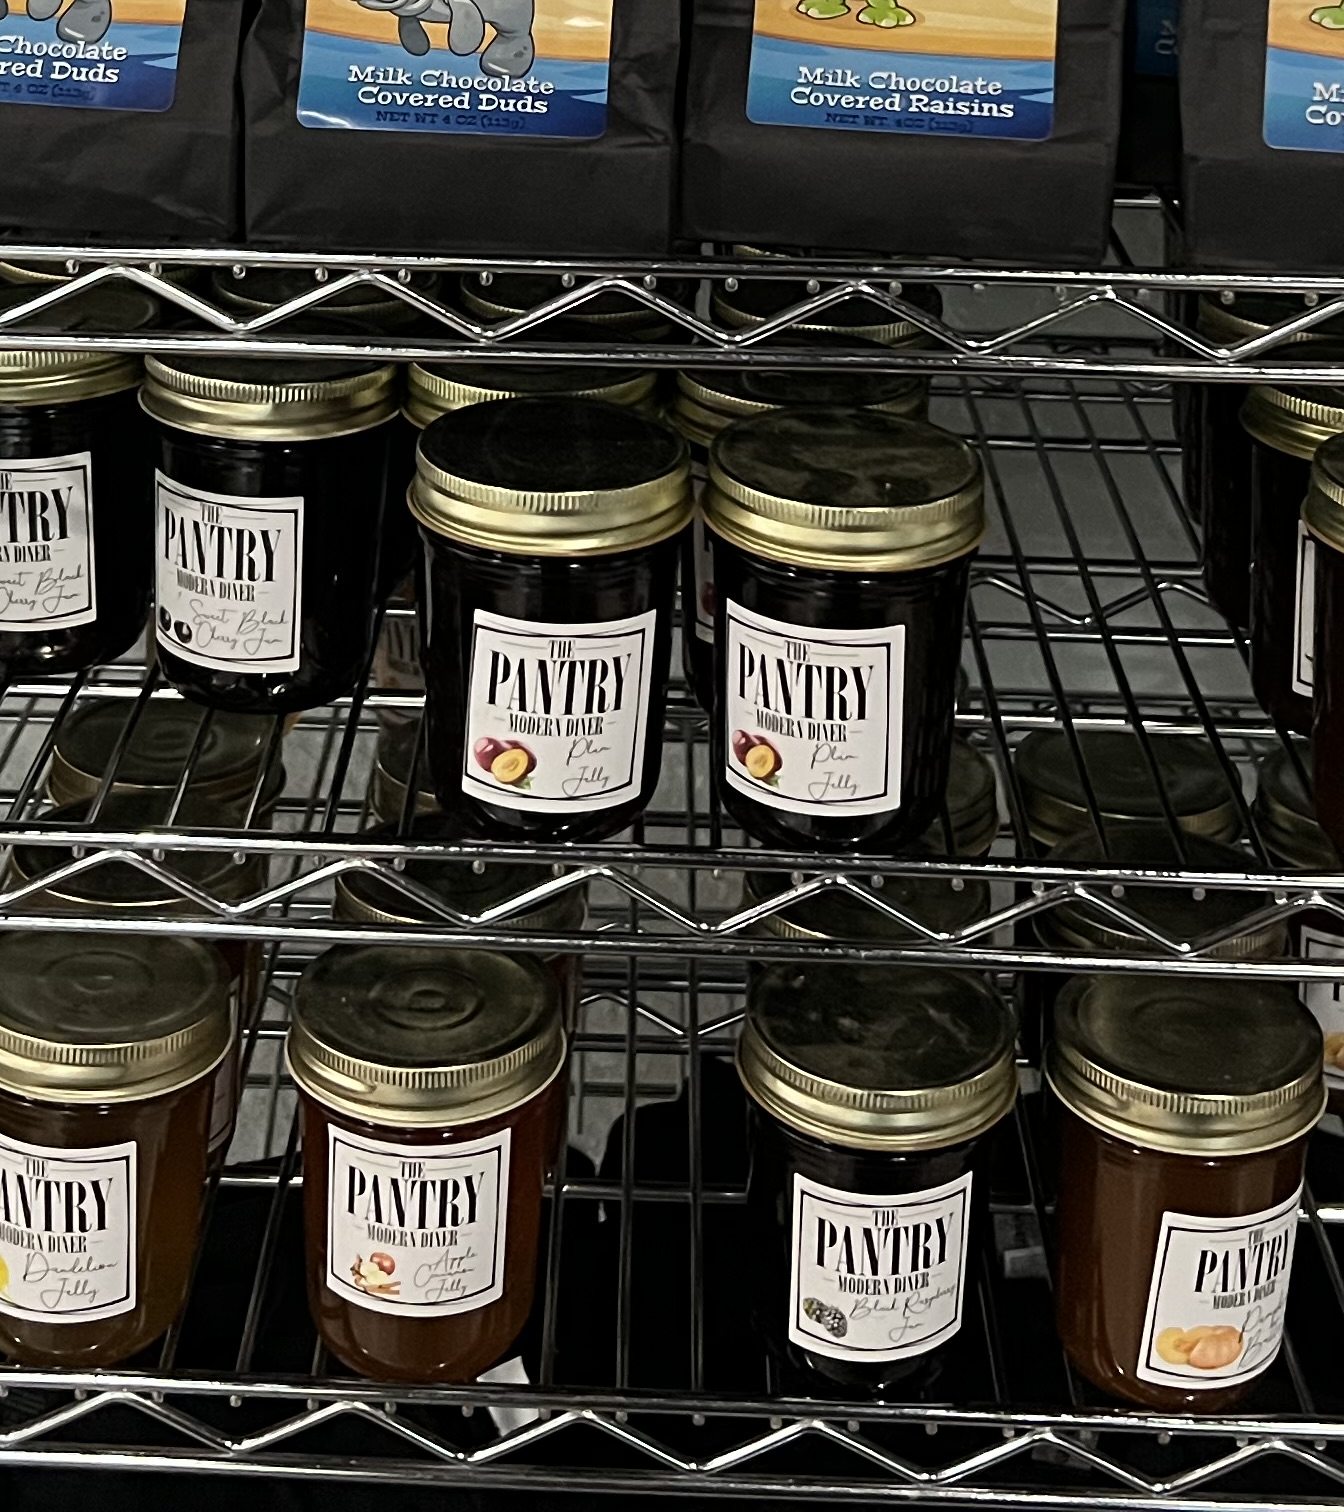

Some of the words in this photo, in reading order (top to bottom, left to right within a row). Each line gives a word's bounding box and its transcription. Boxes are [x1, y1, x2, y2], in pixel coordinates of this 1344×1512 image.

[347, 63, 414, 88] Milk
[419, 69, 555, 96] Chocolate
[357, 85, 471, 112] Covered
[476, 91, 549, 116] Duds
[376, 111, 410, 123] NET
[165, 505, 281, 583] PANTRY
[486, 648, 632, 716] PANTRY
[738, 642, 875, 721] PANTRY
[561, 765, 610, 797] Jelly
[807, 771, 858, 801] Jelly
[346, 1164, 486, 1231] PANTRY
[815, 1211, 955, 1277] PANTRY
